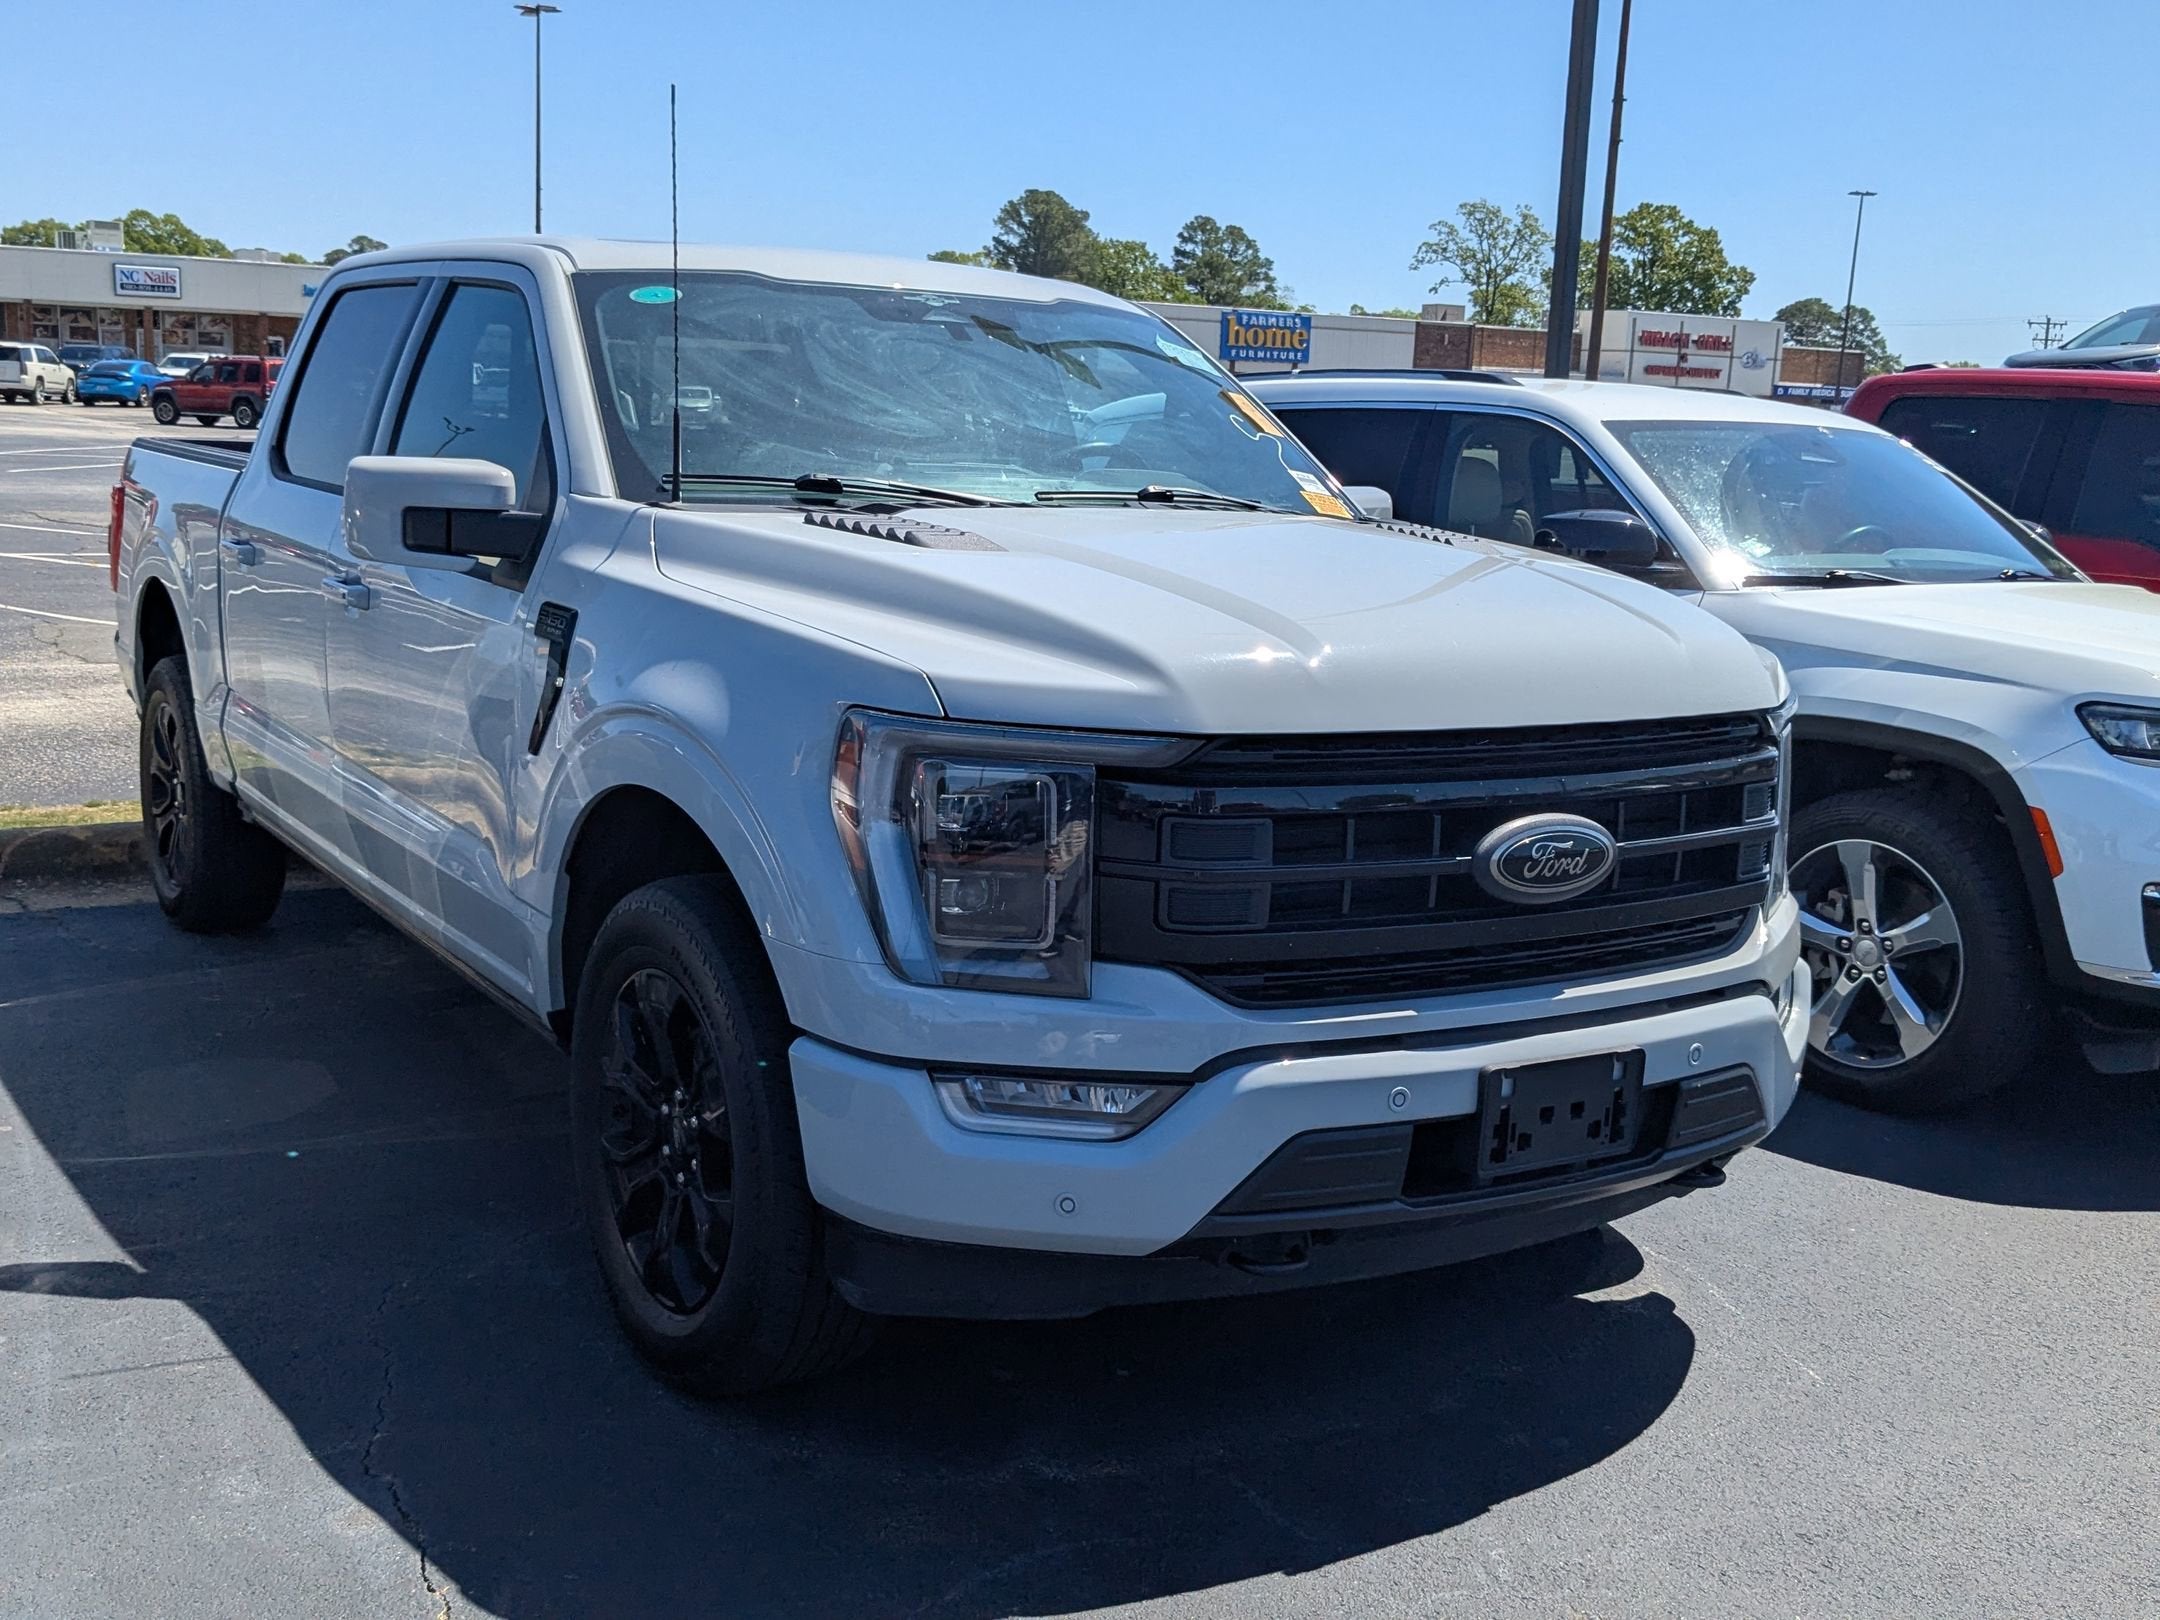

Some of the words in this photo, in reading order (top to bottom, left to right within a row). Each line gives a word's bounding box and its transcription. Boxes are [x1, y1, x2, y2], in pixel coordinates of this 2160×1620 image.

[120, 269, 140, 283] NC
[144, 271, 177, 285] Nails
[1241, 314, 1301, 328] FARMERS
[1226, 315, 1308, 350] home
[1230, 349, 1303, 361] FURNITURE
[1787, 387, 1810, 396] FAMILY
[1811, 388, 1836, 397] MEDICA
[1523, 840, 1590, 879] Ford
